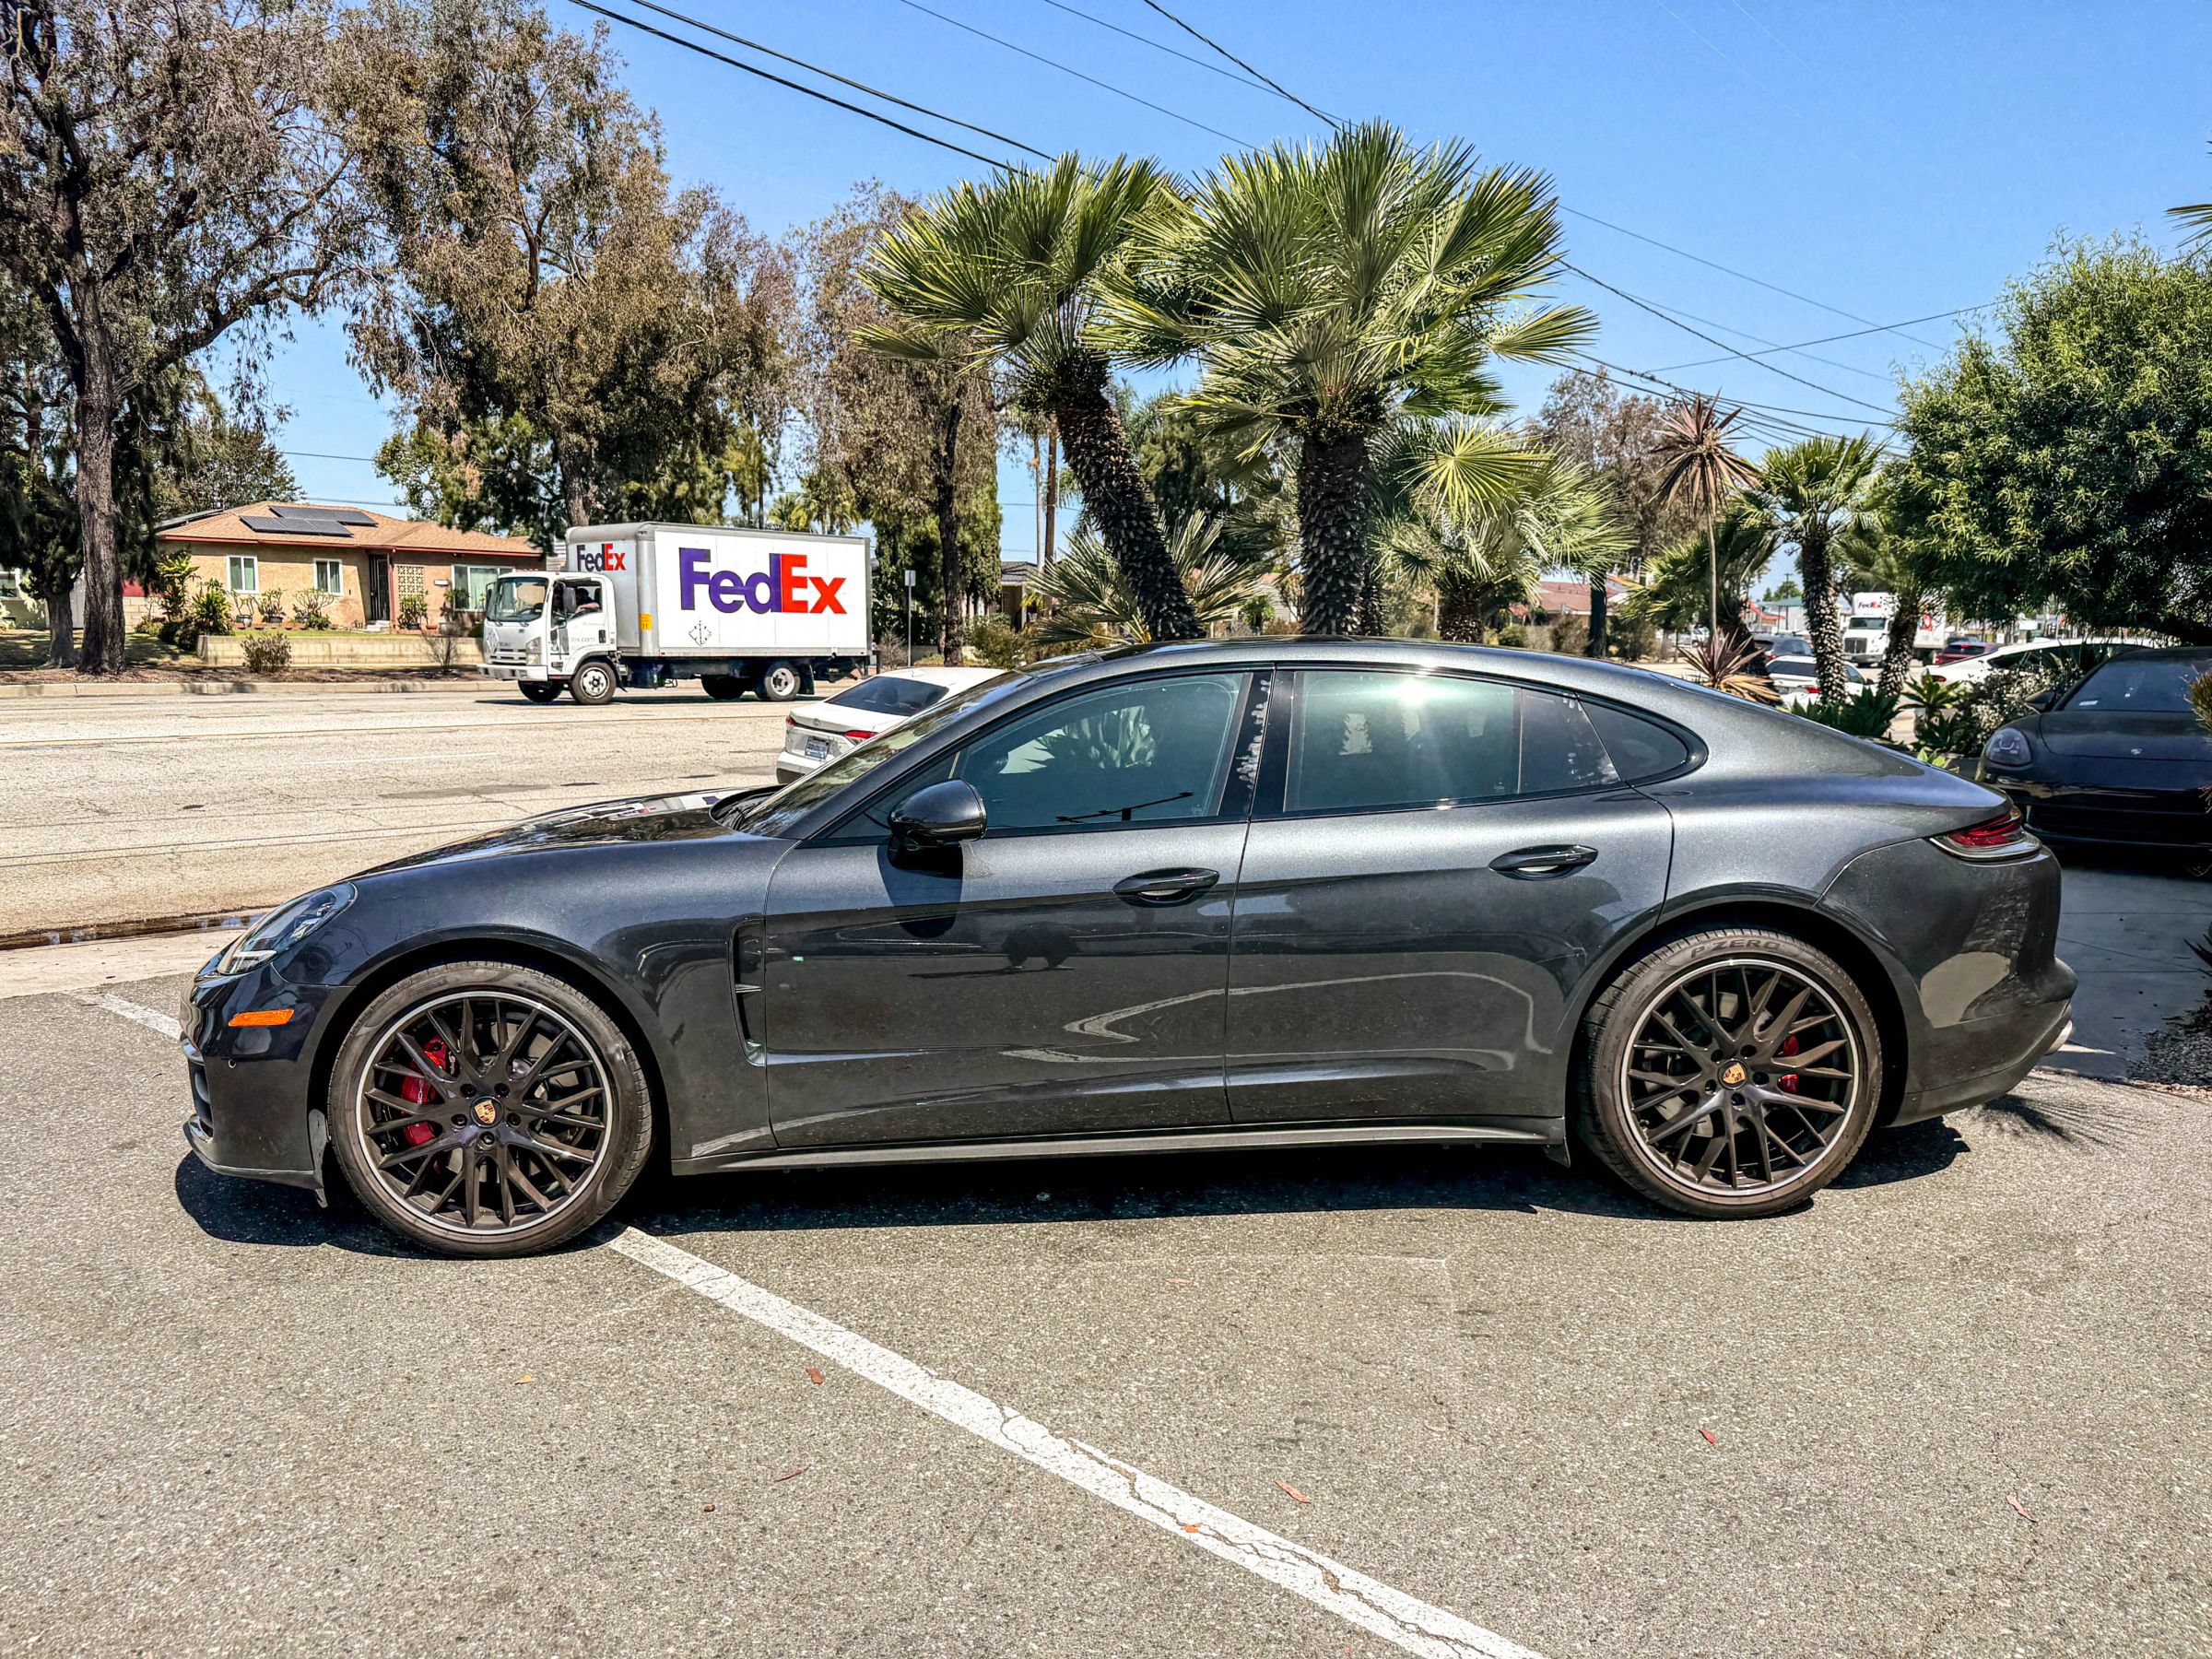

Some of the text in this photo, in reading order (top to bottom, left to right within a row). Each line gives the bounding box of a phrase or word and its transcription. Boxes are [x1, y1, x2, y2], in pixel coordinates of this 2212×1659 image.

[577, 543, 627, 571] FedEx
[678, 547, 848, 614] FedEx
[1690, 939, 1781, 959] P ZERO
